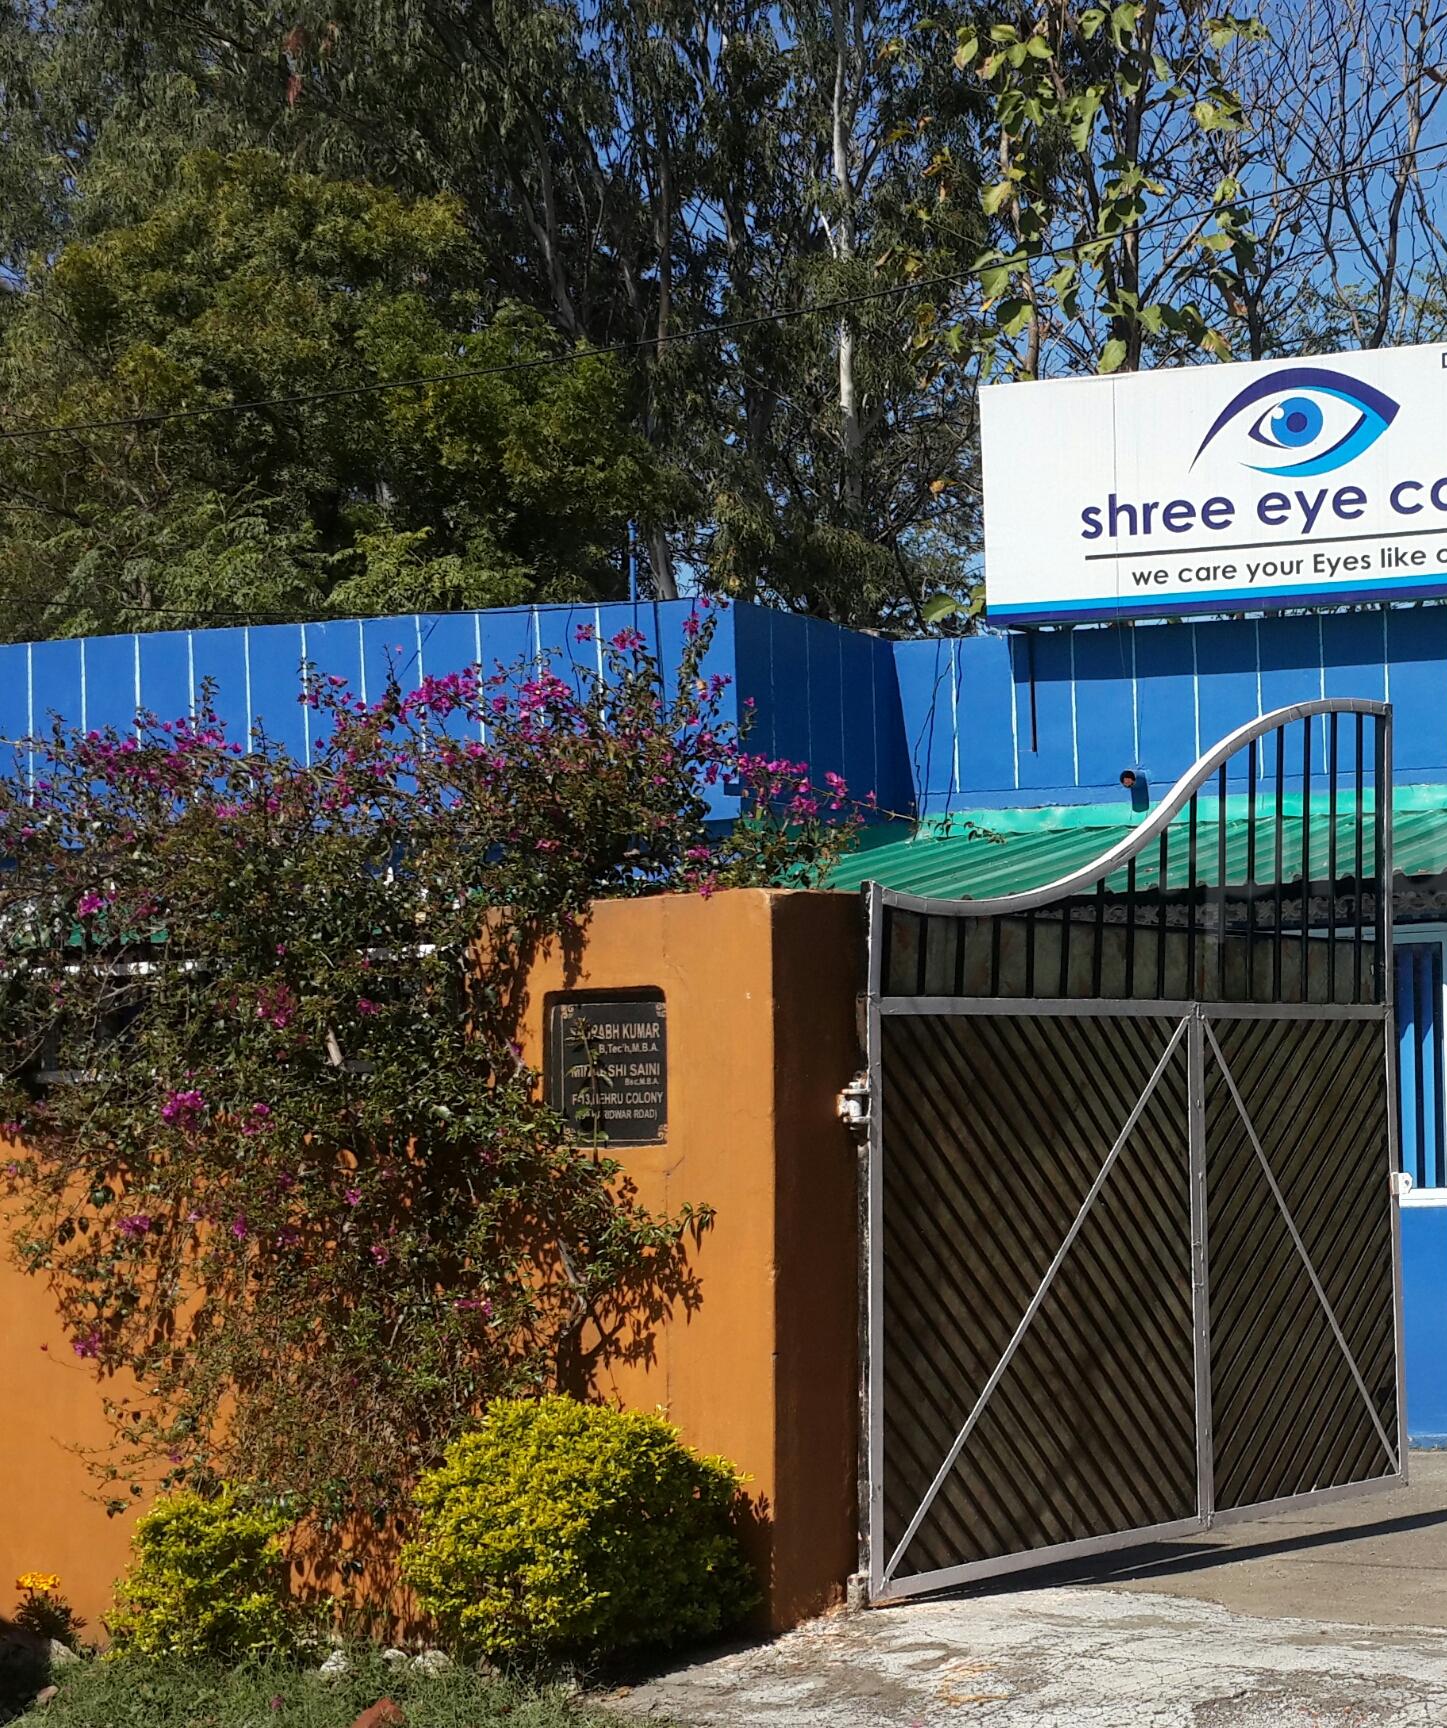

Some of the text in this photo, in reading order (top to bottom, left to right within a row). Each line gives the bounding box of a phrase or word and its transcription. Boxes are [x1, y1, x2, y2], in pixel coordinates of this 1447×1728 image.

[1081, 493, 1236, 541] shree
[1256, 485, 1368, 535] eye
[1131, 569, 1169, 586] we
[1178, 564, 1237, 583] care
[1246, 559, 1304, 583] your
[1313, 552, 1371, 578] Eyes
[1380, 547, 1427, 568] like
[622, 1022, 660, 1039] KUMAR
[629, 1062, 660, 1076] SAINI
[625, 1091, 664, 1104] COLONY
